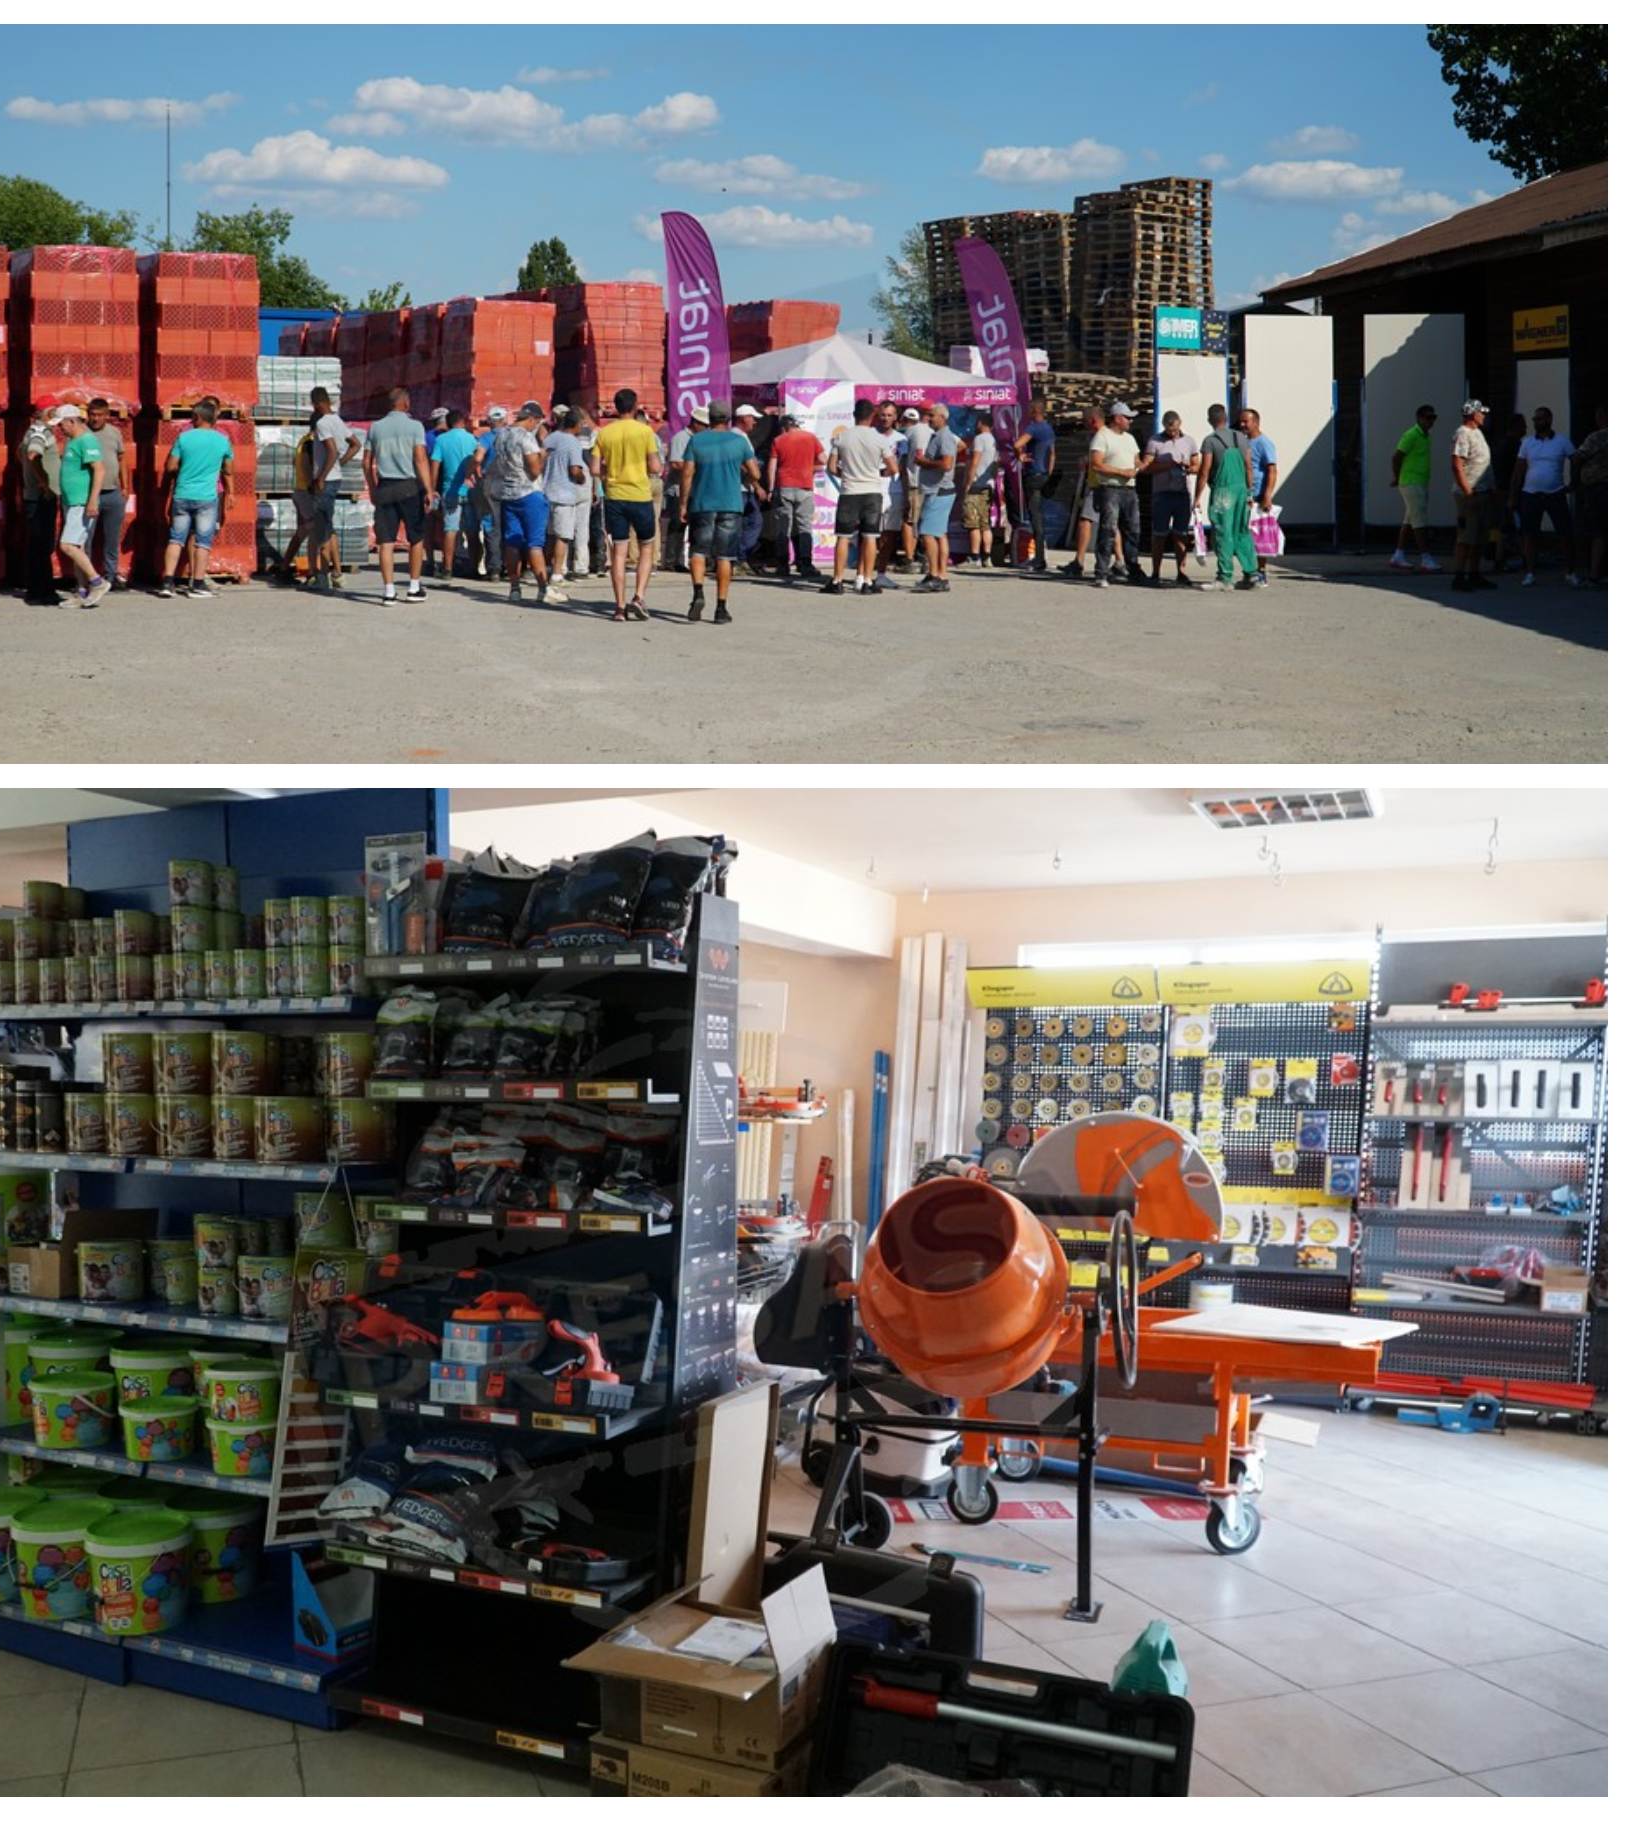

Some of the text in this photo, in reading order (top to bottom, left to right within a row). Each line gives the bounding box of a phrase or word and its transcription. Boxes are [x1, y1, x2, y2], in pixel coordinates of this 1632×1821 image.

[678, 278, 711, 417] siniat
[977, 295, 1022, 430] sniat
[888, 388, 926, 402] siniat
[975, 386, 1013, 401] siniat
